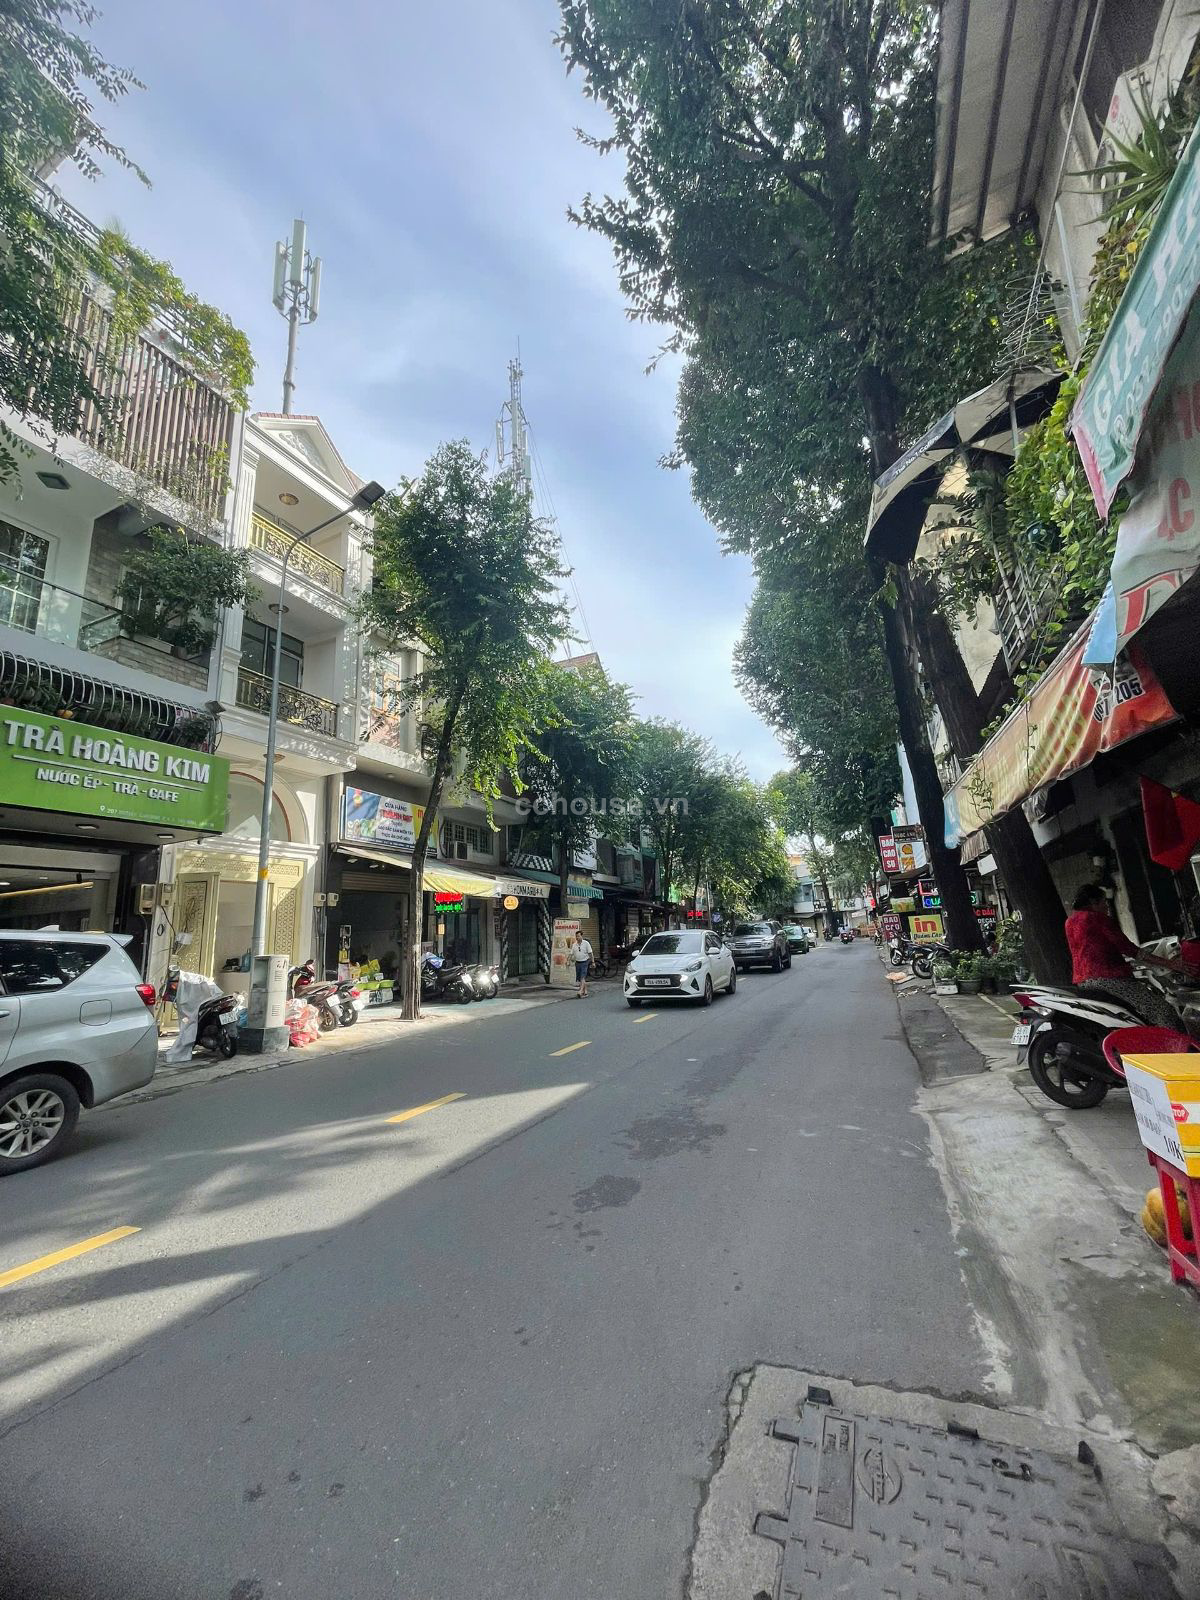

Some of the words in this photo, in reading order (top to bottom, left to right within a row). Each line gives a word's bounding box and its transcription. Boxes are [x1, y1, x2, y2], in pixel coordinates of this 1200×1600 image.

[1115, 677, 1143, 704] 205
[3, 719, 65, 756] TRÀ
[71, 736, 160, 773] HOÀNG
[165, 755, 210, 784] KIM
[112, 779, 138, 797] TRÀ
[883, 916, 898, 924] BAO
[914, 917, 937, 933] in
